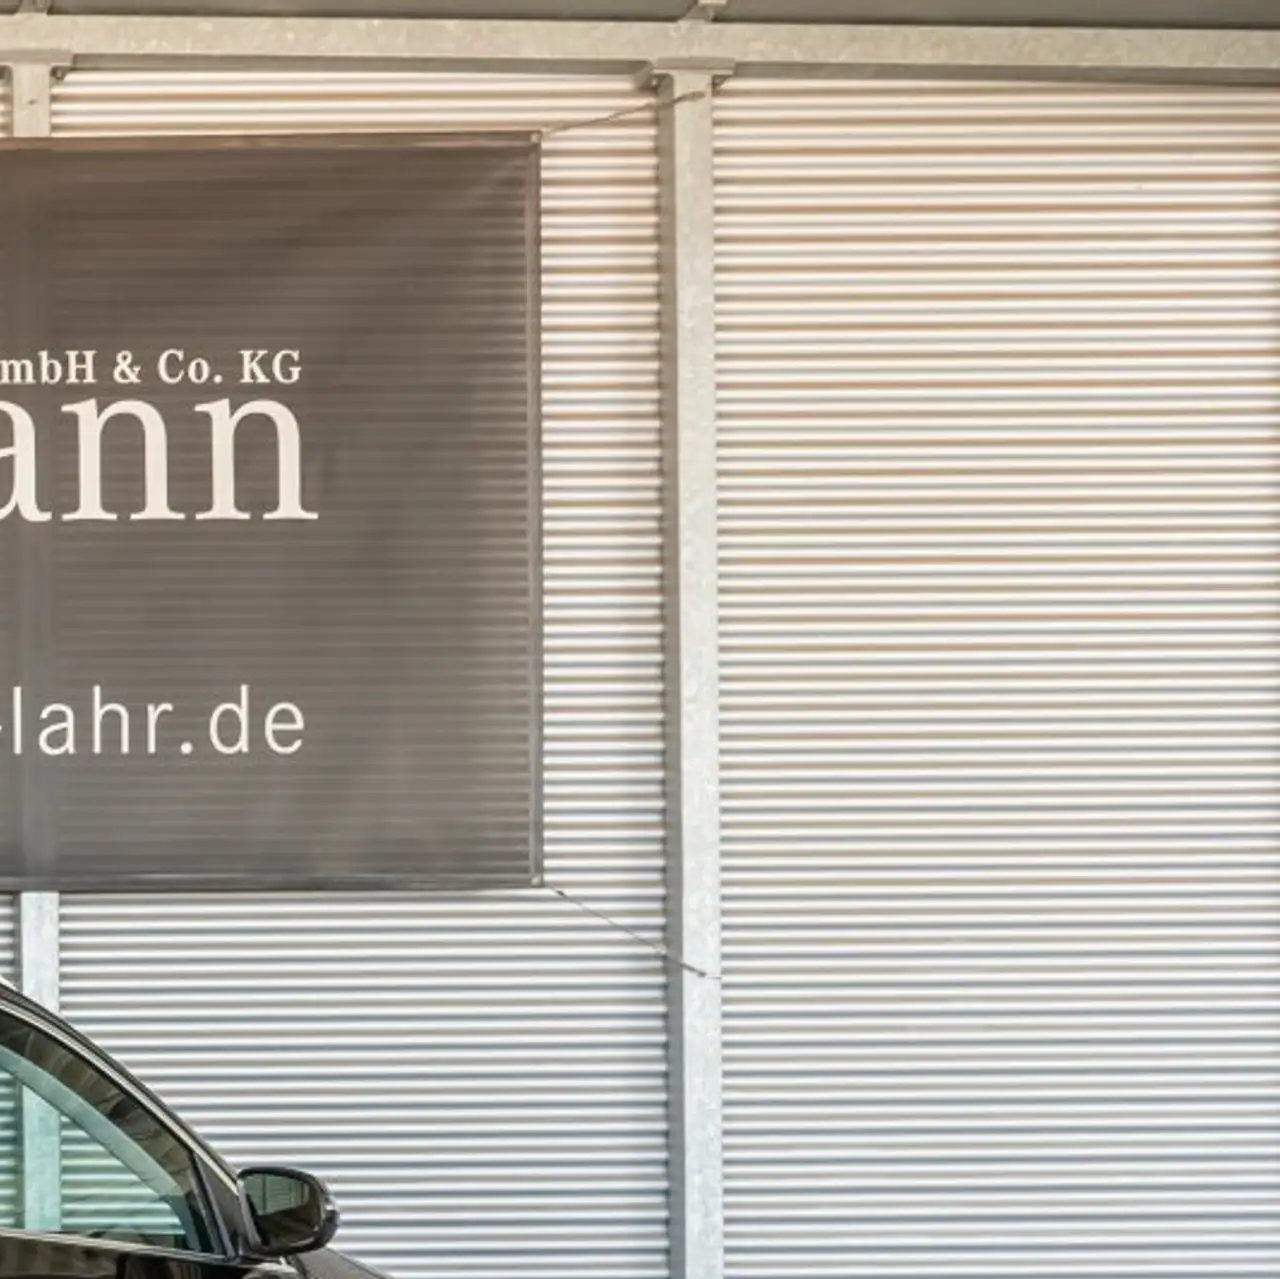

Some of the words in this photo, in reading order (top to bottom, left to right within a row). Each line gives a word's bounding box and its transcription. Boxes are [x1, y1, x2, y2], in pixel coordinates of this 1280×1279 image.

[112, 349, 142, 384] &
[157, 348, 223, 384] Co.
[239, 348, 302, 384] KG
